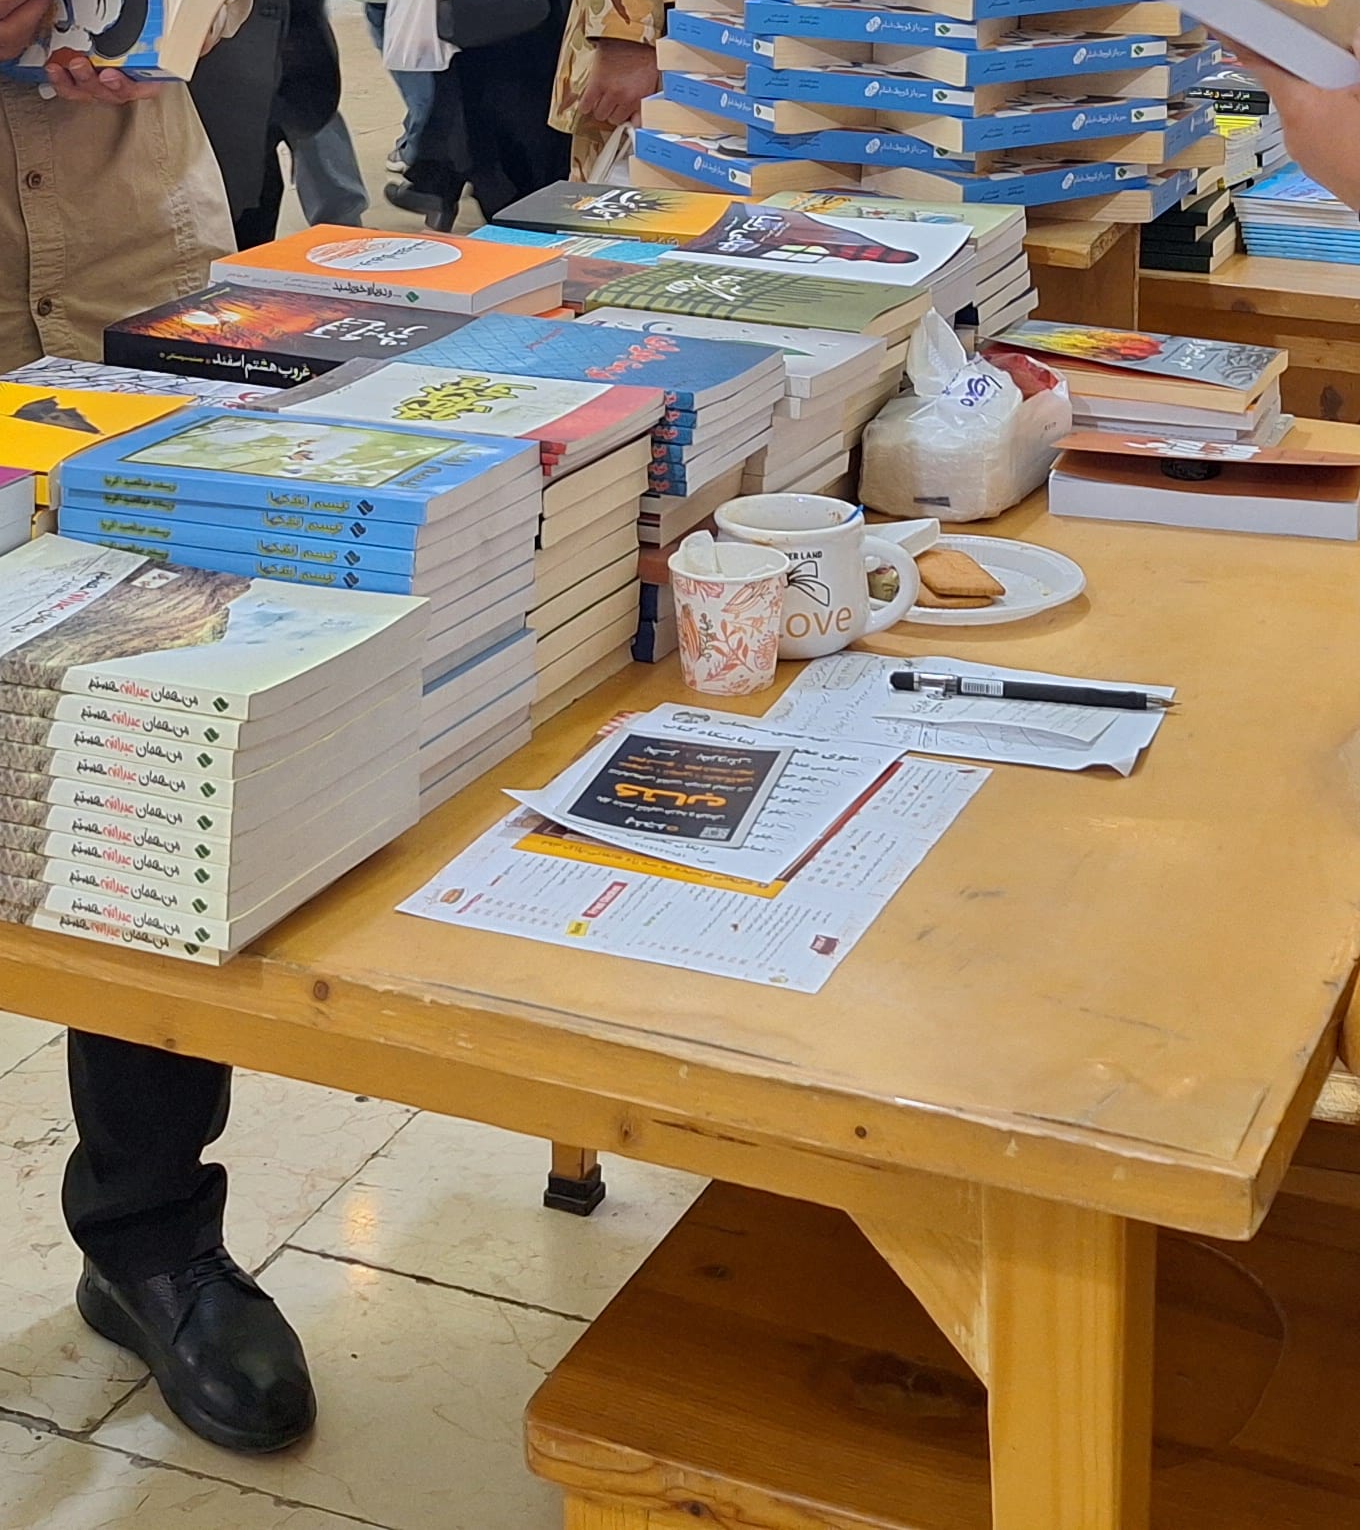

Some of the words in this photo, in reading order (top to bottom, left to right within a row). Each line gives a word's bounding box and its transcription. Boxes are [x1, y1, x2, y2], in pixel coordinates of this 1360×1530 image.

[212, 351, 245, 370] اسفند
[244, 357, 278, 379] هشتم
[277, 364, 311, 381] غروب
[785, 553, 799, 561] ER
[801, 551, 823, 560] LAND
[781, 607, 852, 638] ove
[120, 680, 149, 701] عبدالله
[113, 710, 142, 731] عبدالله
[106, 736, 135, 756] عبدالله
[615, 781, 727, 807] کتاب
[106, 796, 135, 816] عبدالله
[104, 848, 132, 868] عبدالله
[101, 876, 130, 896] عبدالله
[92, 920, 120, 940] عبدالله
